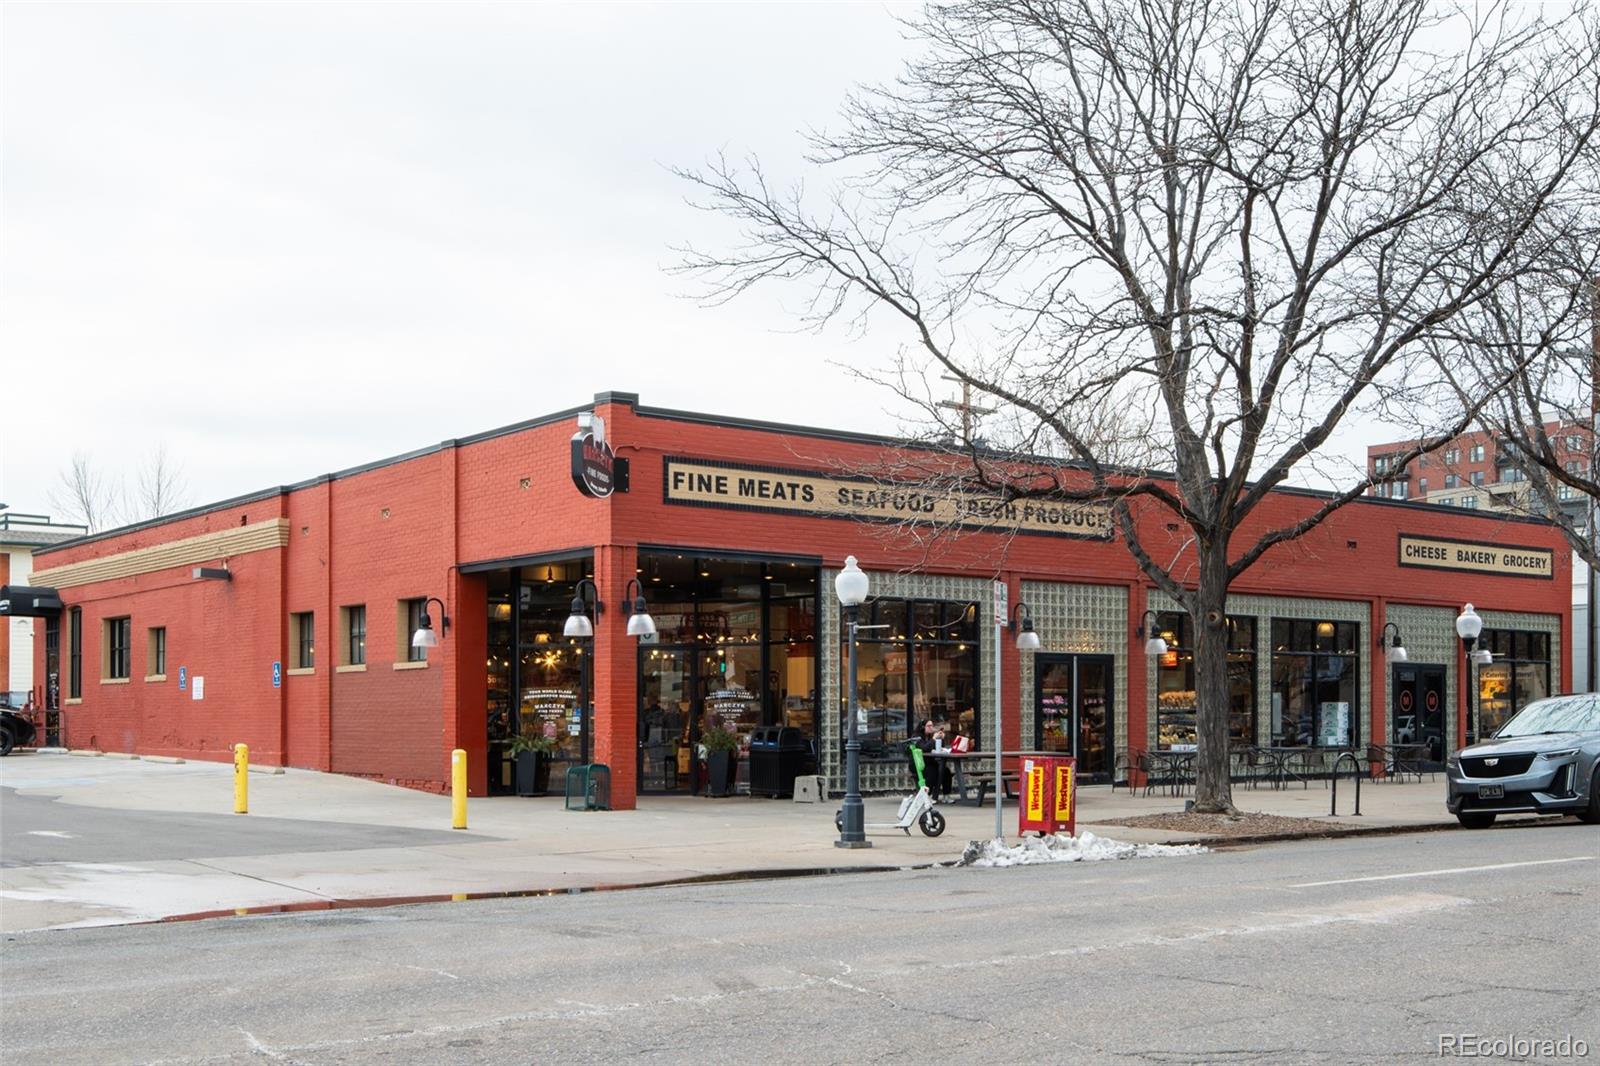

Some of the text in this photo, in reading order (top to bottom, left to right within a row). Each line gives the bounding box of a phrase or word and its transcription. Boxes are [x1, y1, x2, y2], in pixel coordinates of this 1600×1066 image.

[672, 471, 728, 495] FINE
[738, 477, 815, 503] MEATS
[956, 499, 1017, 520] RESH
[1405, 544, 1547, 569] CHEESE BAKERY GROCERY
